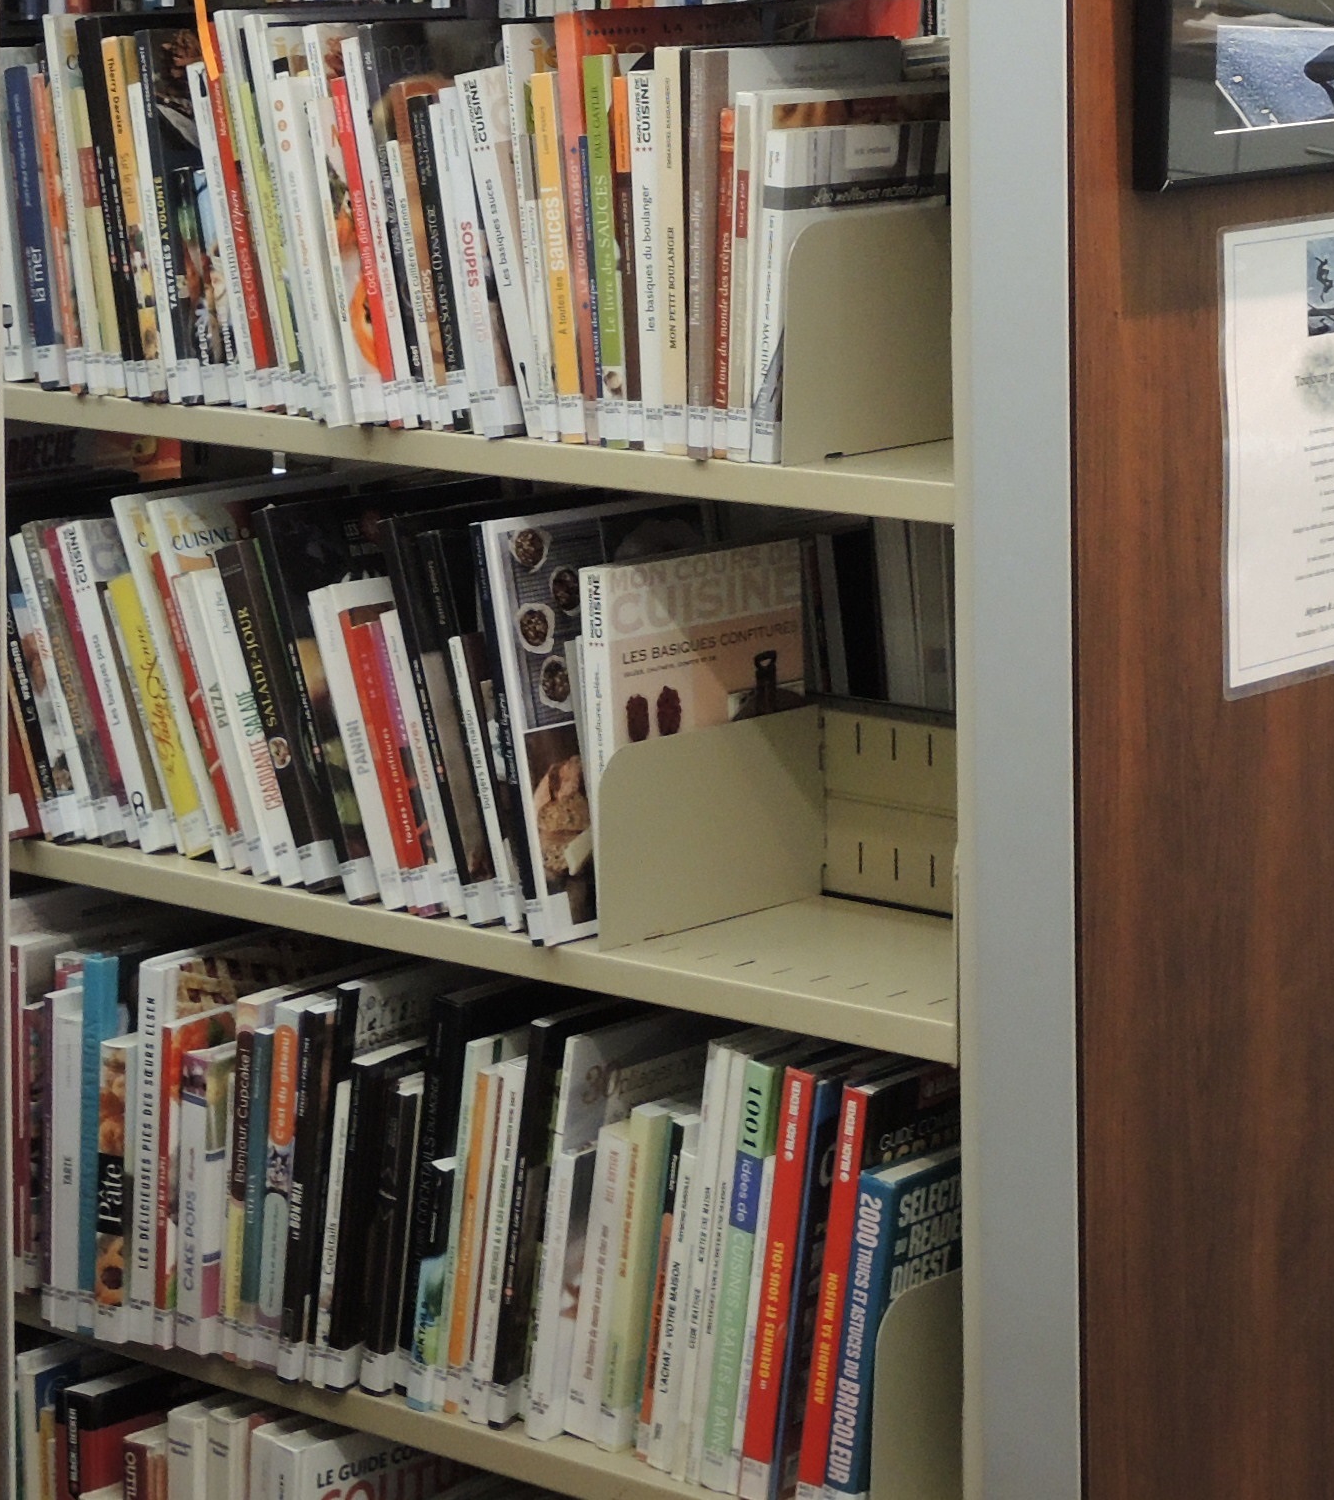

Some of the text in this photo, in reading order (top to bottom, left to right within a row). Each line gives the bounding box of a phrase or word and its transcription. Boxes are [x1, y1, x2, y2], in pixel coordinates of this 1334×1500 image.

[154, 175, 168, 229] VOLONTÉ
[593, 174, 617, 333] Le livre des SAUCES
[666, 226, 677, 349] MON PETIT BOULANGER
[9, 640, 33, 700] wagamama
[622, 620, 799, 666] LES BASIQUES CONFITURES
[208, 682, 230, 729] PIZZA
[234, 688, 284, 810] CRAQUANTE SALADE
[345, 718, 371, 776] PANINI
[274, 1107, 287, 1140] C'est
[276, 1086, 289, 1104] du
[741, 1084, 764, 1149] 1001
[98, 1163, 125, 1224] Pâte
[182, 1190, 197, 1291] CAKE POPS
[813, 1272, 839, 1405] AGRANDIR SA MAISON
[828, 1192, 884, 1484] 2000 TRUCS ET ASTUCES DU BRICOLEUR
